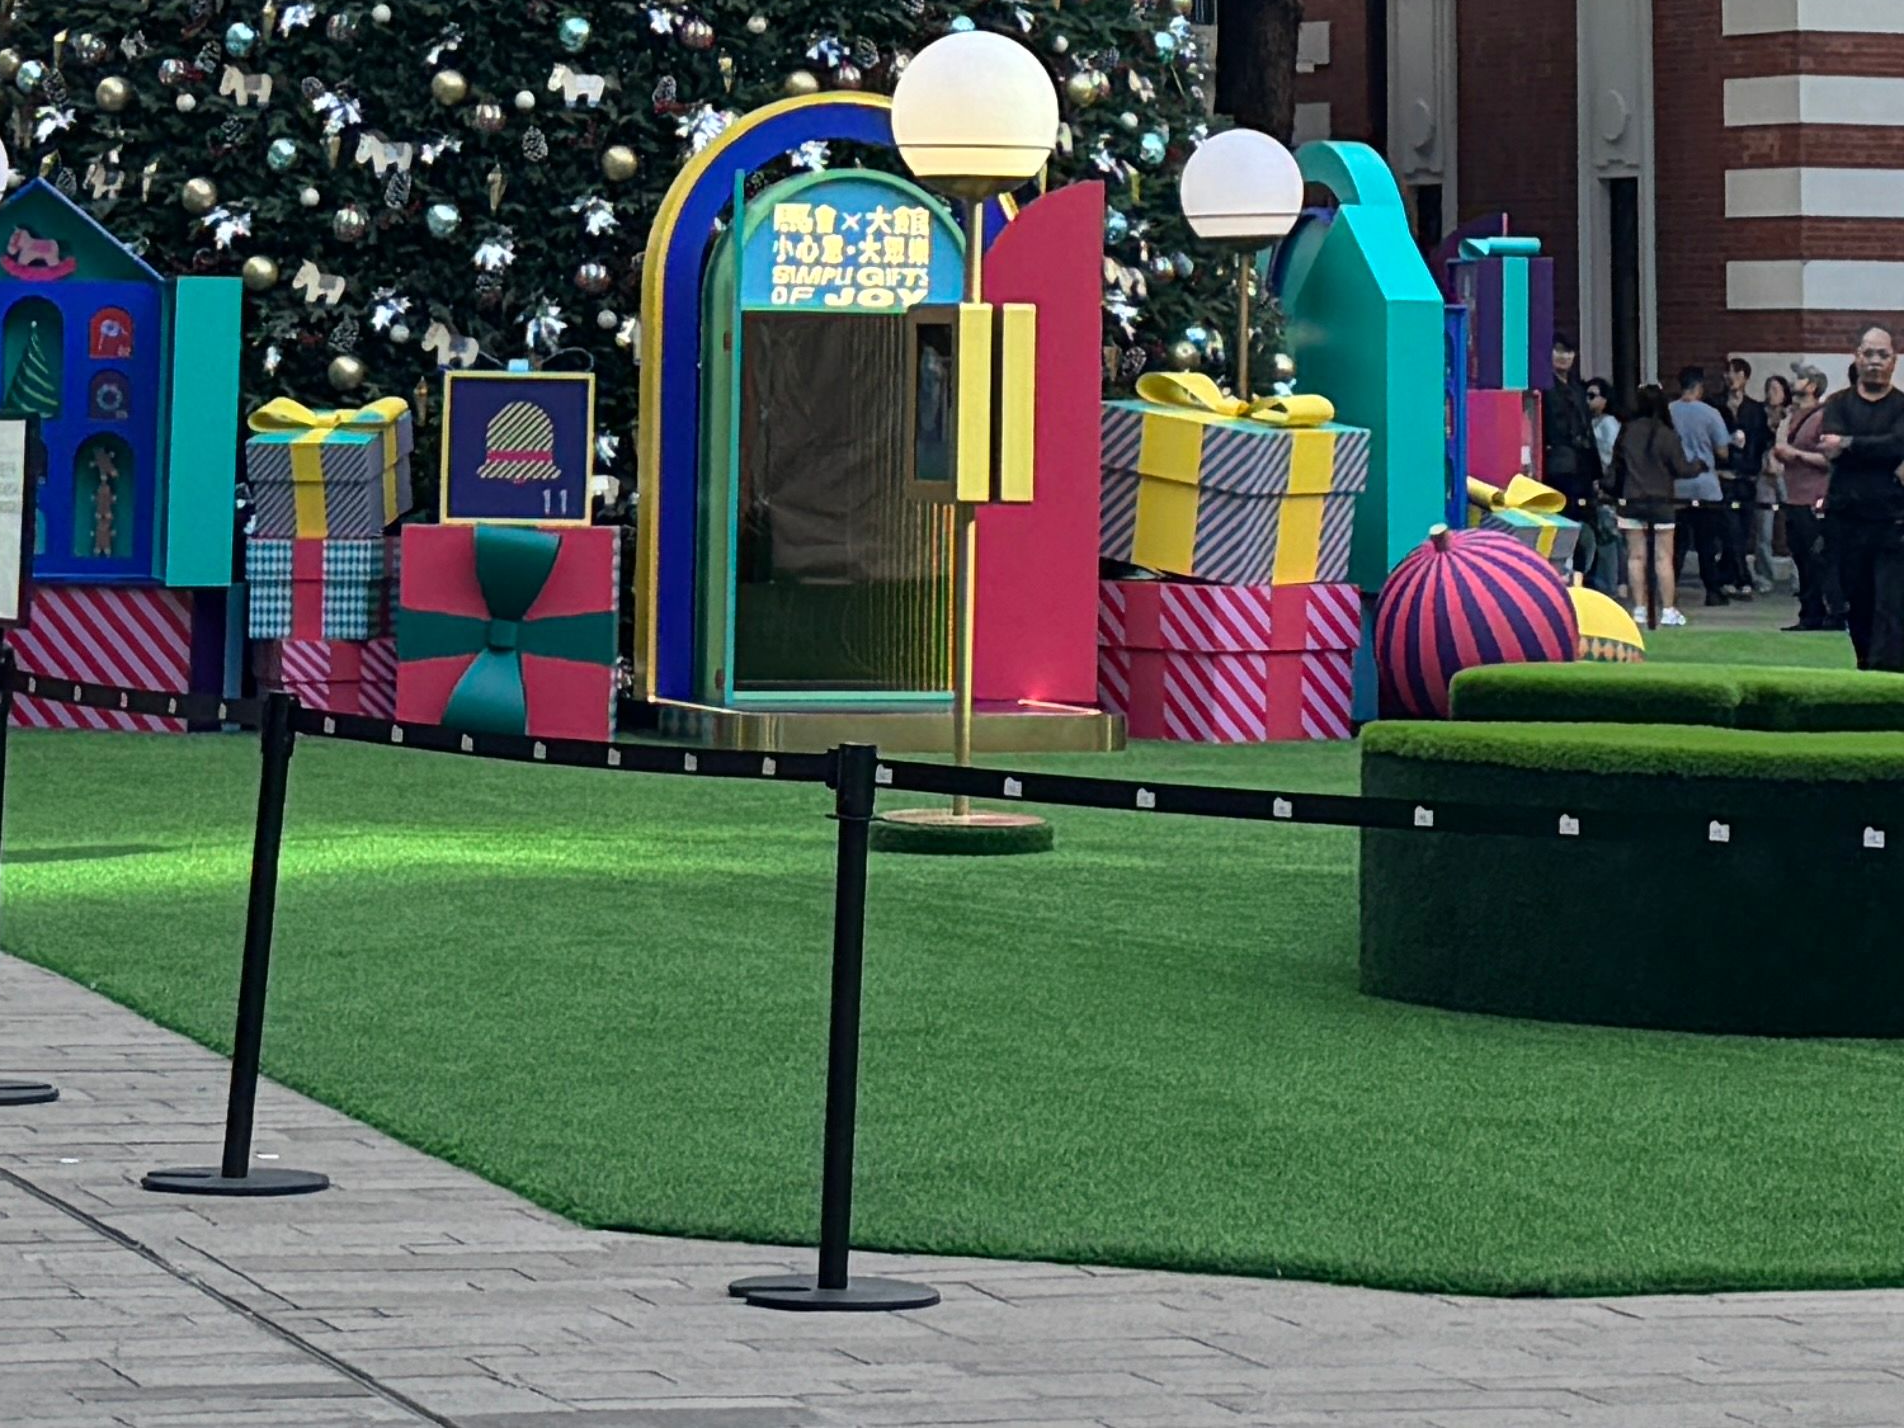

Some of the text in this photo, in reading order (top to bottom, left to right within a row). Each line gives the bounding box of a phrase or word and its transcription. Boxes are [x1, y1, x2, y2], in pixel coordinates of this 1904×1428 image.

[771, 286, 929, 308] OF JOY
[542, 488, 568, 515] 11
